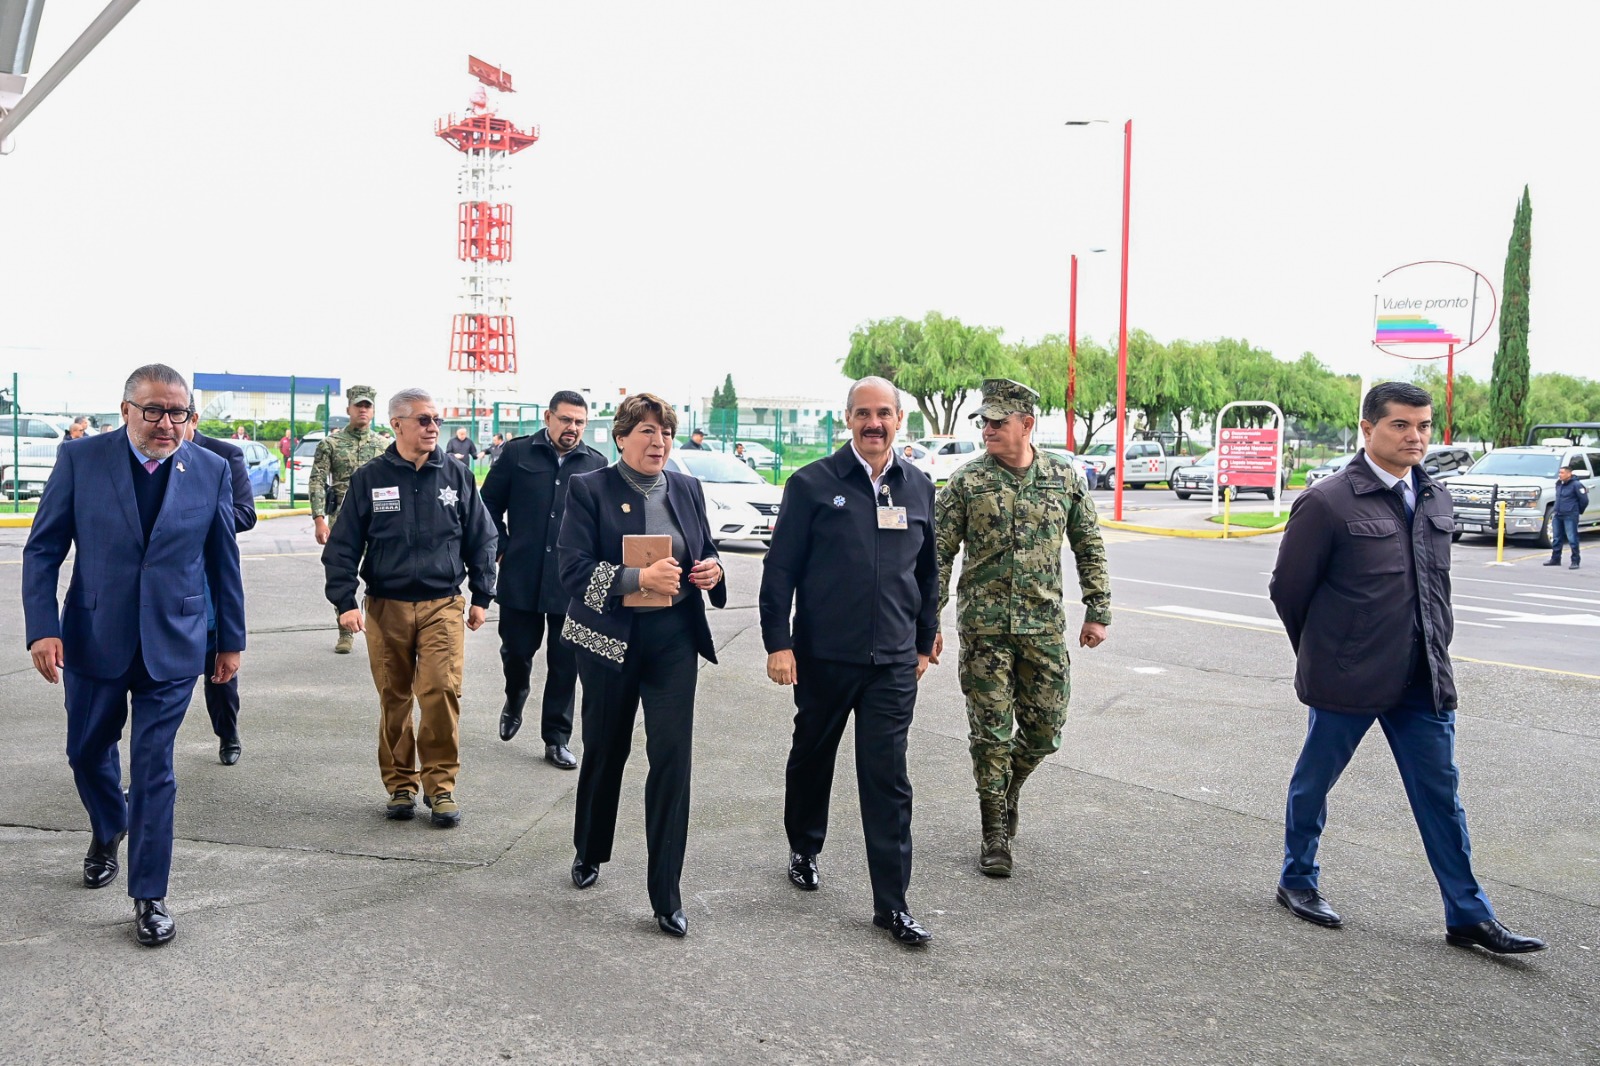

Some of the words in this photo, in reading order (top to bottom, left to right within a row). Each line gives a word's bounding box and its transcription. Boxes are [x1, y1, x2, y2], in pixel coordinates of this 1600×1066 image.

[1383, 298, 1423, 309] Vuelve
[1424, 297, 1469, 311] pronto
[484, 423, 489, 432] E
